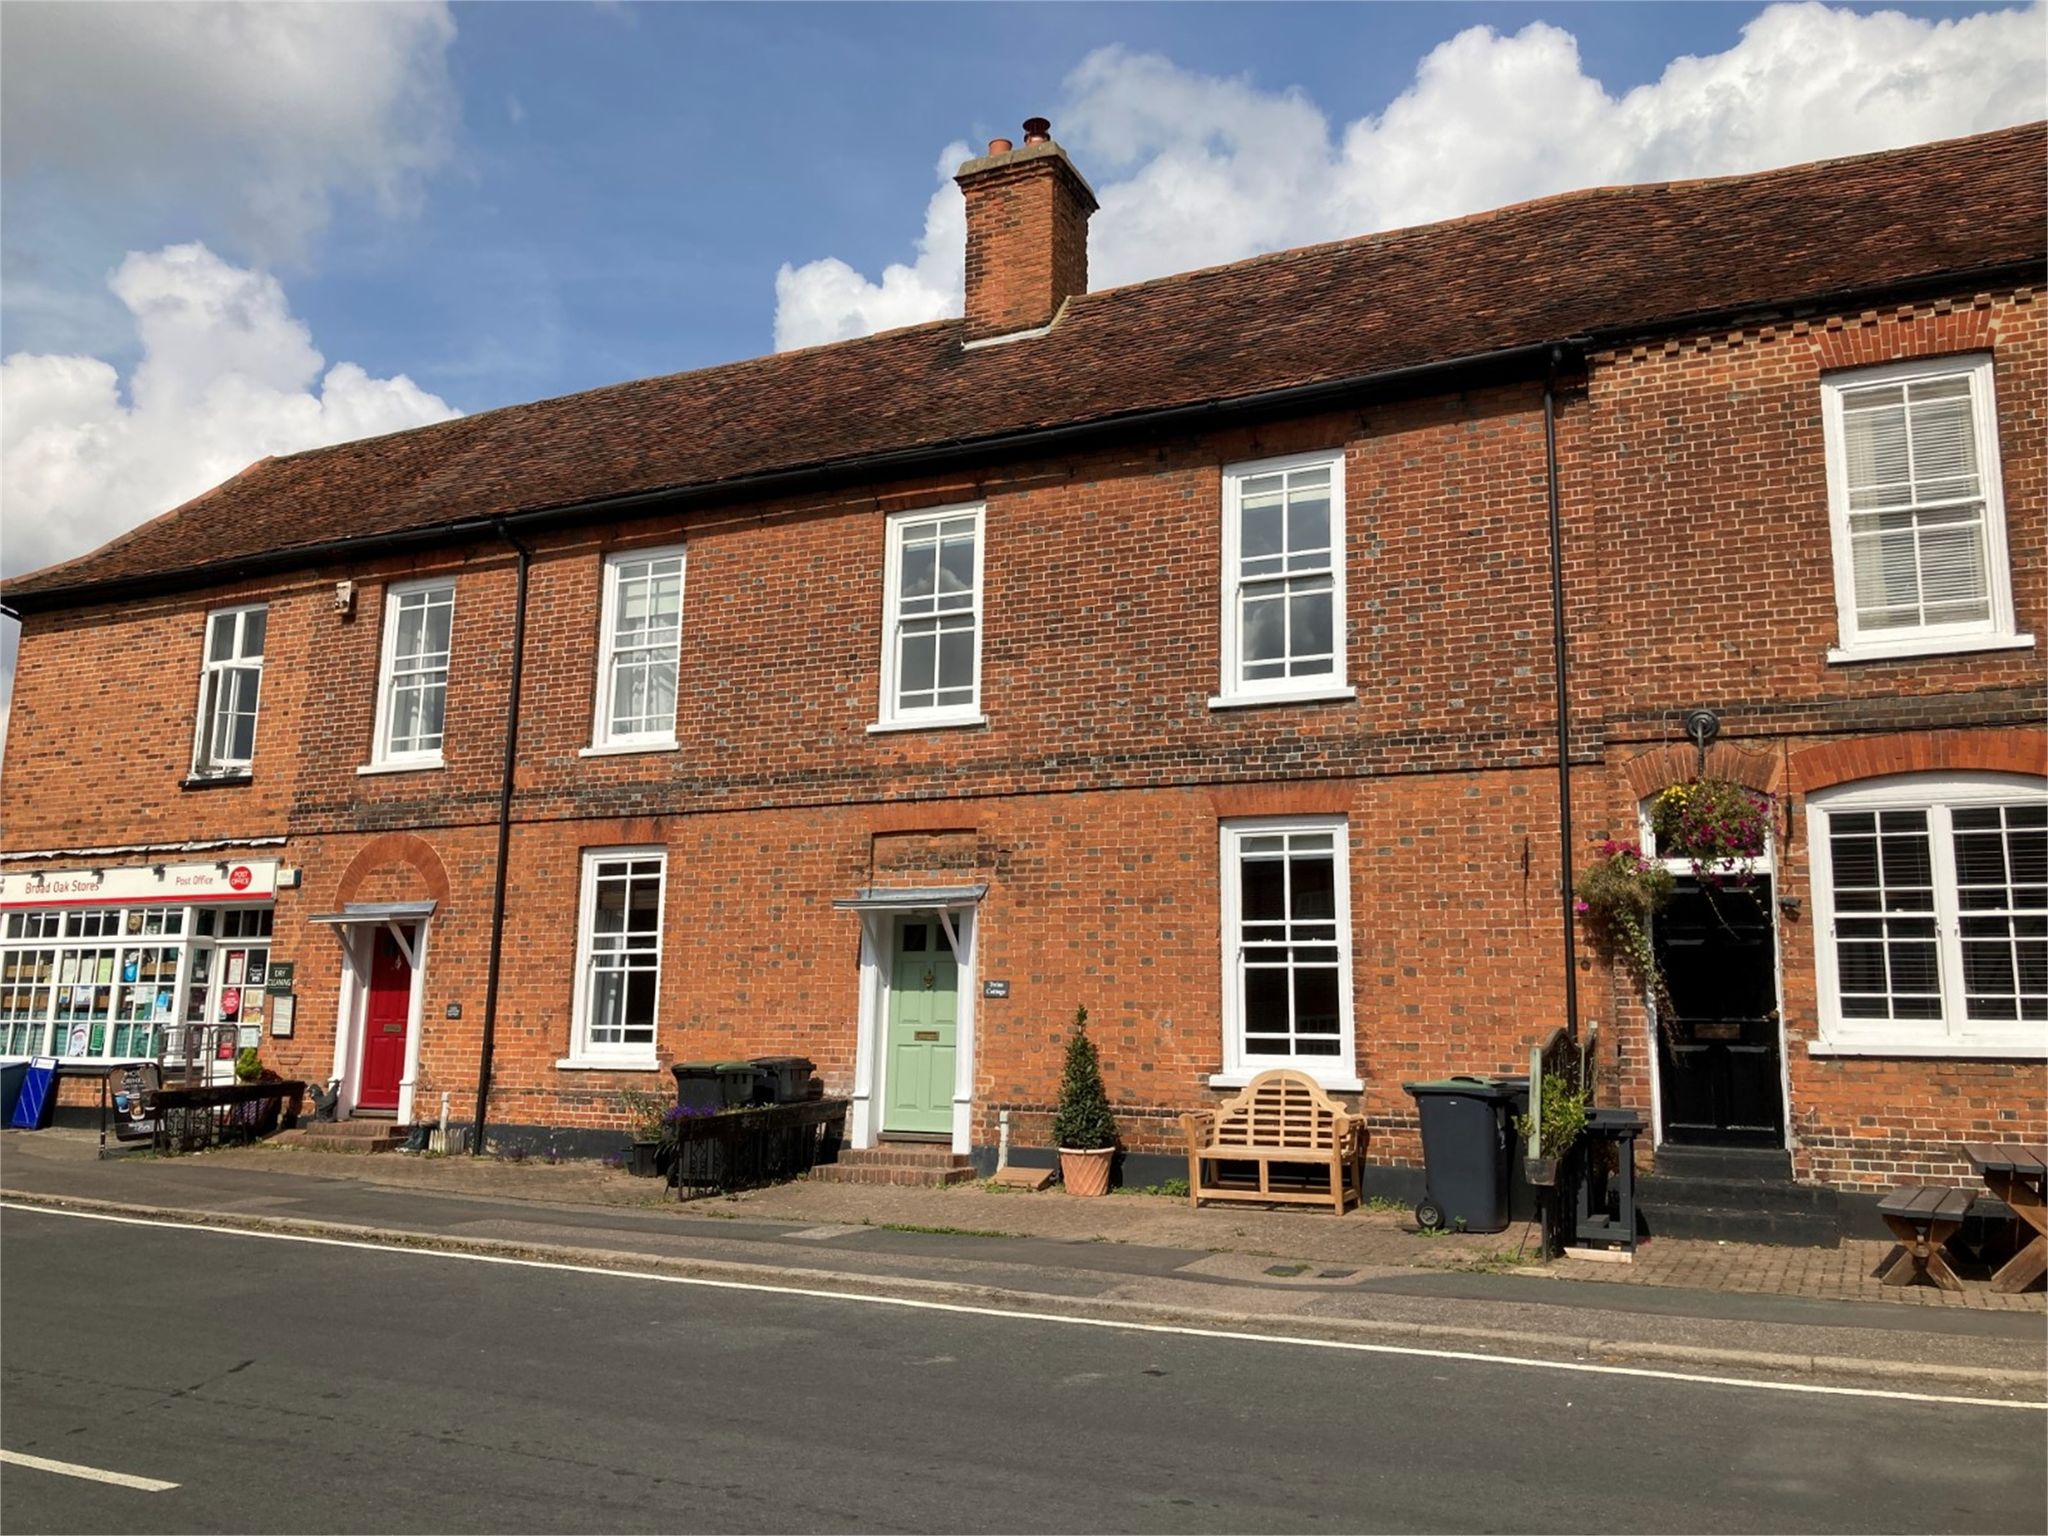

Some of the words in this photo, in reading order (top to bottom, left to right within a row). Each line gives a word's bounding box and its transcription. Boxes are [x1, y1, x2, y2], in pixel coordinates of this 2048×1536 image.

[233, 870, 248, 878] POST
[176, 876, 191, 886] Post
[192, 874, 214, 885] Office
[231, 876, 250, 886] OFFICE
[25, 882, 51, 894] Broad
[53, 881, 69, 893] Oak
[71, 880, 100, 892] Stores
[274, 969, 286, 977] DRY
[266, 978, 292, 986] CLEANING
